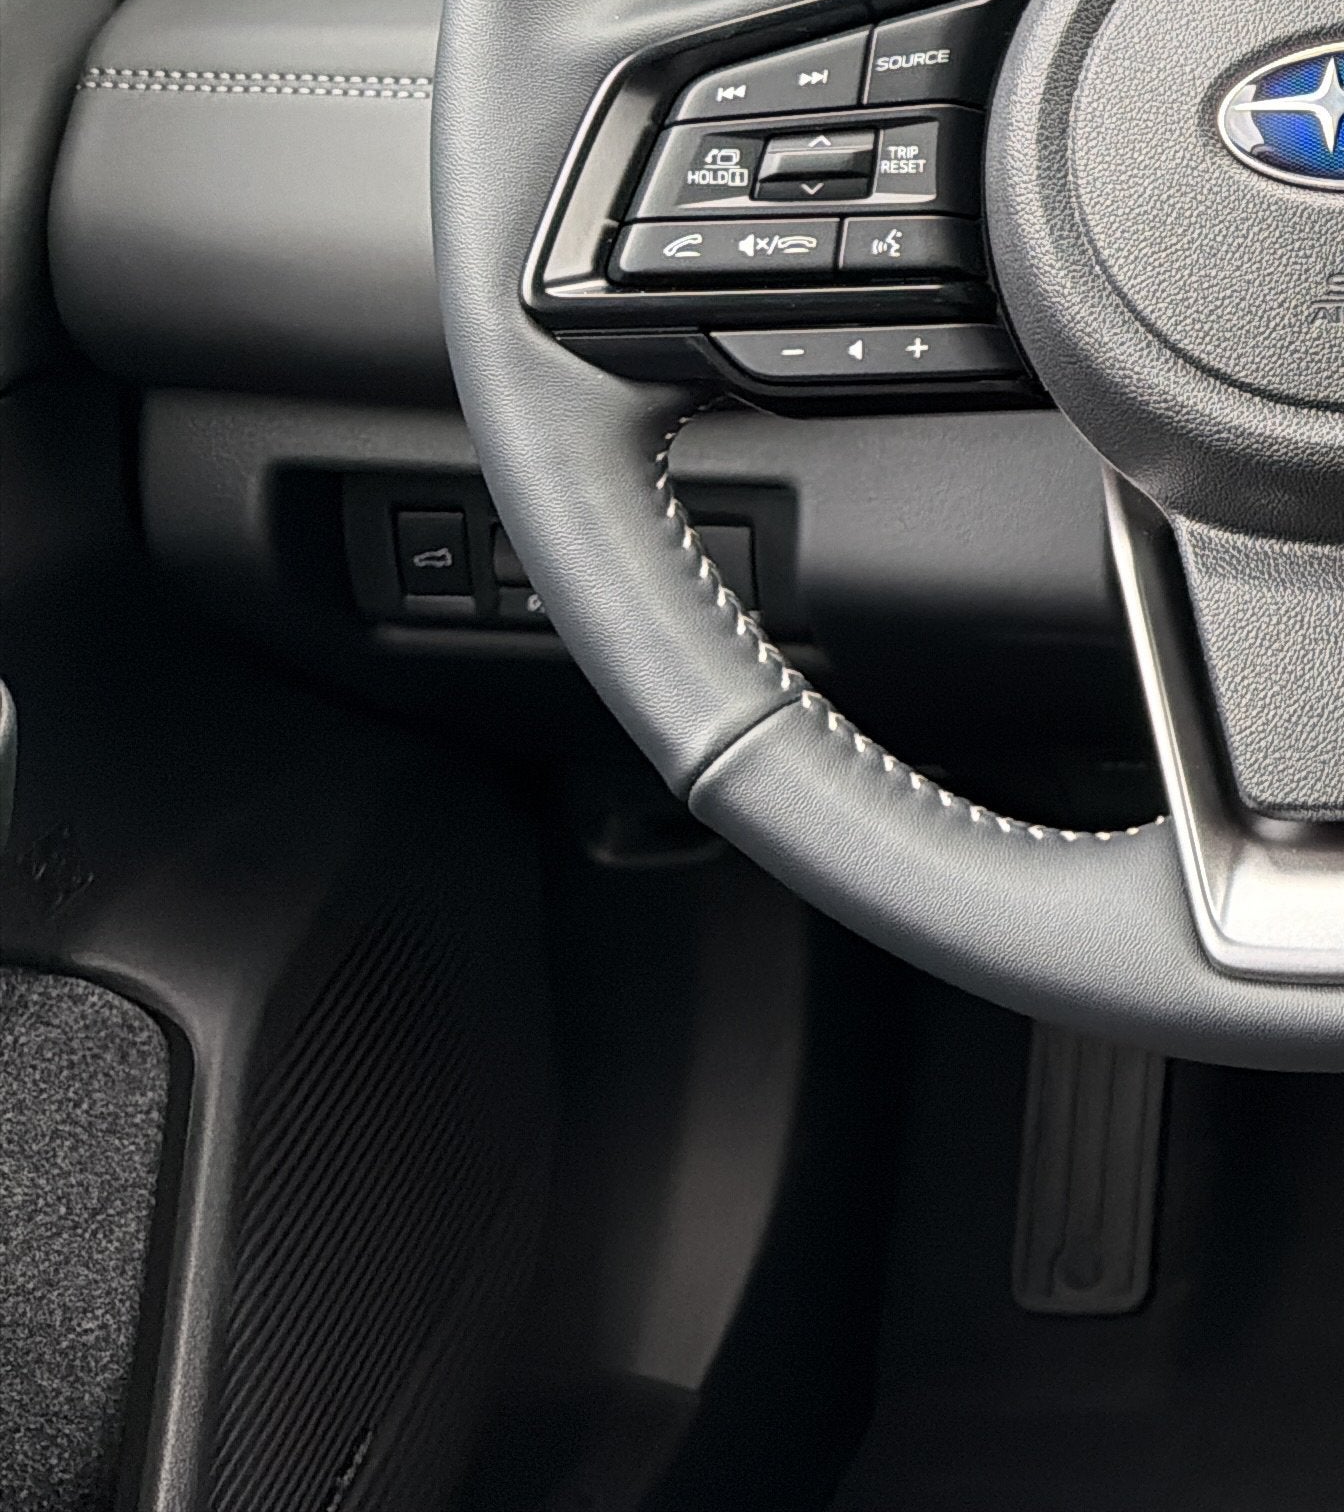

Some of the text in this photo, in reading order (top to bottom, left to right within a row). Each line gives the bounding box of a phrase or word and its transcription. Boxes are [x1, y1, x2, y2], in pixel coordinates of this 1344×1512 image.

[875, 49, 951, 72] SOURCE
[888, 146, 919, 160] TRIP
[880, 158, 927, 174] RESET
[687, 170, 729, 185] HOLD
